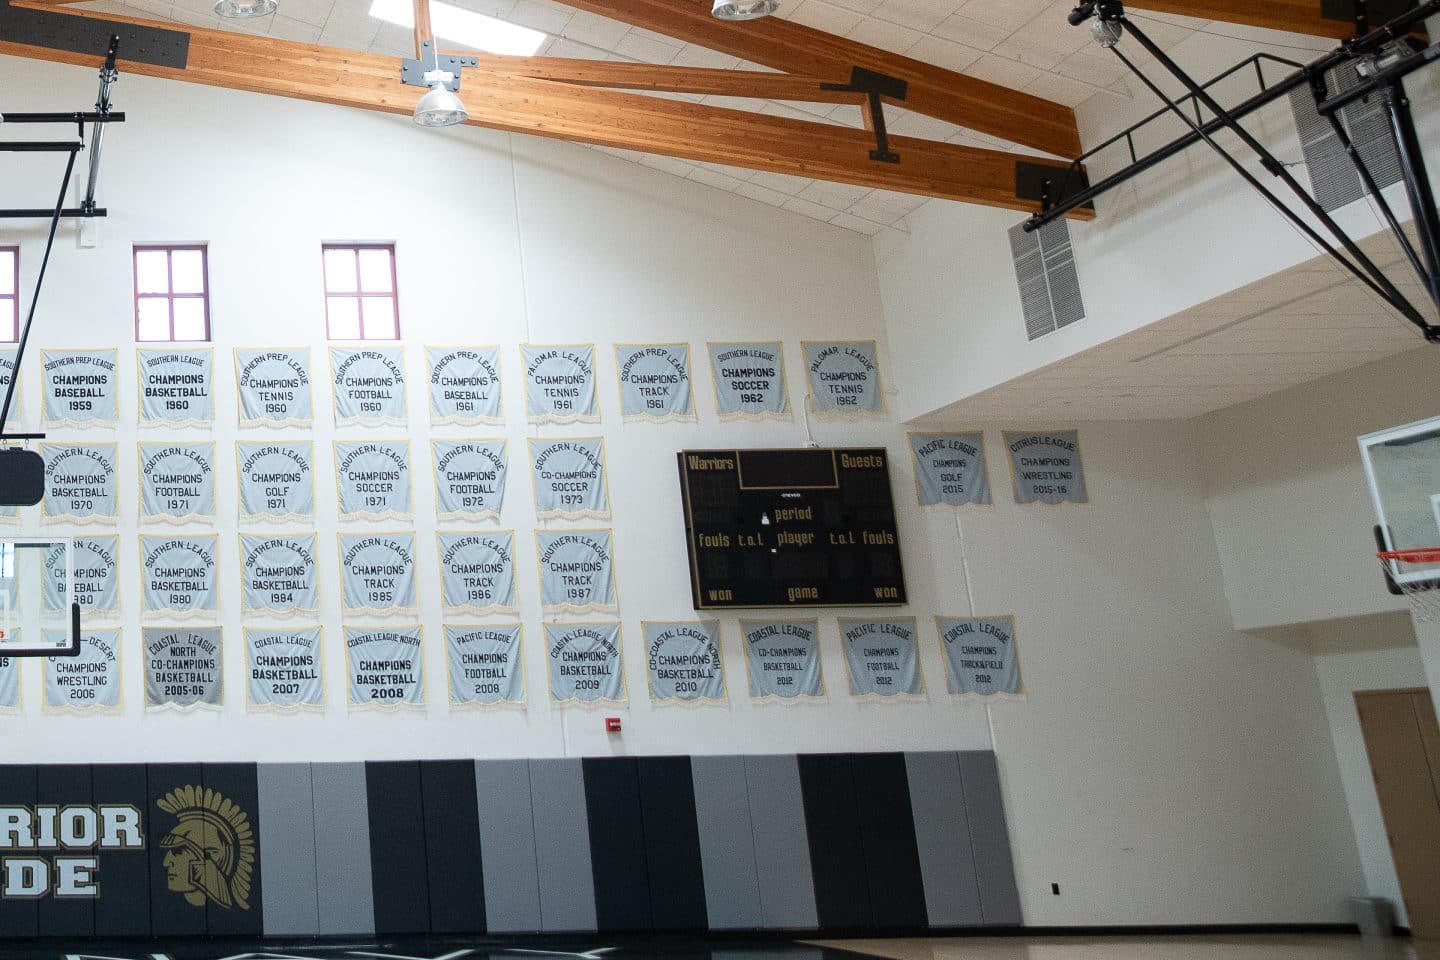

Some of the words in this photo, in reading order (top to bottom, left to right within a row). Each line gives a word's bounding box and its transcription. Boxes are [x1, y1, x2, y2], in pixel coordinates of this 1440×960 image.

[717, 349, 748, 362] SOUTHERN
[750, 350, 775, 362] LEAGUE
[44, 357, 75, 371] SOUTHERN
[75, 356, 92, 364] PREP
[92, 358, 116, 371] LEAGUE
[146, 355, 179, 367] SOUTHERN
[180, 355, 204, 367] LEAGUE
[722, 368, 775, 378] CHAMPIONS
[53, 375, 107, 385] CHAMPIONS
[149, 374, 204, 384] CHAMPIONS
[731, 381, 769, 390] SOCCER
[55, 388, 105, 397] BASEBALL
[145, 387, 208, 397] BASKETBALL
[741, 393, 763, 403] 1962
[69, 401, 92, 410] 1959
[166, 400, 189, 410] 1960
[918, 439, 945, 458] PACIFIC
[949, 440, 978, 457] LEAGUE
[1038, 436, 1077, 452] LEAGUE
[689, 456, 734, 470] Warriors
[842, 454, 882, 468] Guests
[933, 459, 967, 468] CHAMPIONS
[1021, 458, 1070, 466] CHAMPIONS
[153, 474, 203, 484] CHAMPIONS
[447, 471, 496, 481] CHAMPIONS
[940, 473, 962, 482] GOLF
[1022, 472, 1072, 480] WRESTLING
[155, 487, 200, 497] FOOTBALL
[450, 484, 495, 494] FOOTBALL
[942, 484, 964, 494] 2015
[1033, 485, 1067, 494] 2015-16
[168, 500, 189, 509] 1971
[463, 496, 484, 507] 1972
[775, 506, 812, 523] period
[699, 533, 730, 547] fouls
[777, 531, 814, 546] player
[863, 530, 893, 544] fouls
[451, 563, 503, 574] CHAMPIONS
[550, 562, 602, 572] CHAMPIONS
[155, 568, 205, 578] CHAMPIONS
[463, 577, 494, 587] TRACK
[562, 576, 592, 585] TRACK
[151, 581, 208, 591] BASKETBALL
[468, 590, 491, 600] 1986
[567, 588, 591, 598] 1987
[709, 590, 732, 600] won
[788, 587, 818, 601] game
[874, 587, 897, 598] won
[170, 594, 191, 604] 1980
[456, 632, 483, 646] PACIFIC
[484, 631, 511, 644] LEAGUE
[943, 622, 975, 643] COASTAL
[979, 622, 1010, 645] LEAGUE
[148, 633, 181, 656] COASTAL
[188, 633, 217, 656] LEAGUE
[254, 636, 283, 648] COASTAL
[286, 636, 313, 648] LEAGUE
[170, 647, 196, 656] NORTH
[961, 646, 997, 655] CHAMPIONS
[256, 655, 313, 666] CHAMPIONS
[462, 653, 508, 664] CHAMPIONS
[659, 654, 710, 665] CHAMPIONS
[151, 659, 215, 670] CO-CHAMPIONS
[156, 672, 213, 683] BASKETBALL
[252, 669, 318, 680] BASKETBALL
[465, 668, 507, 679] FOOTBALL
[657, 669, 714, 679] BASKETBALL
[975, 674, 992, 683] 2012
[165, 685, 204, 696] 2005-06
[272, 684, 299, 694] 2007
[475, 684, 500, 694] 2008
[675, 682, 697, 692] 2010
